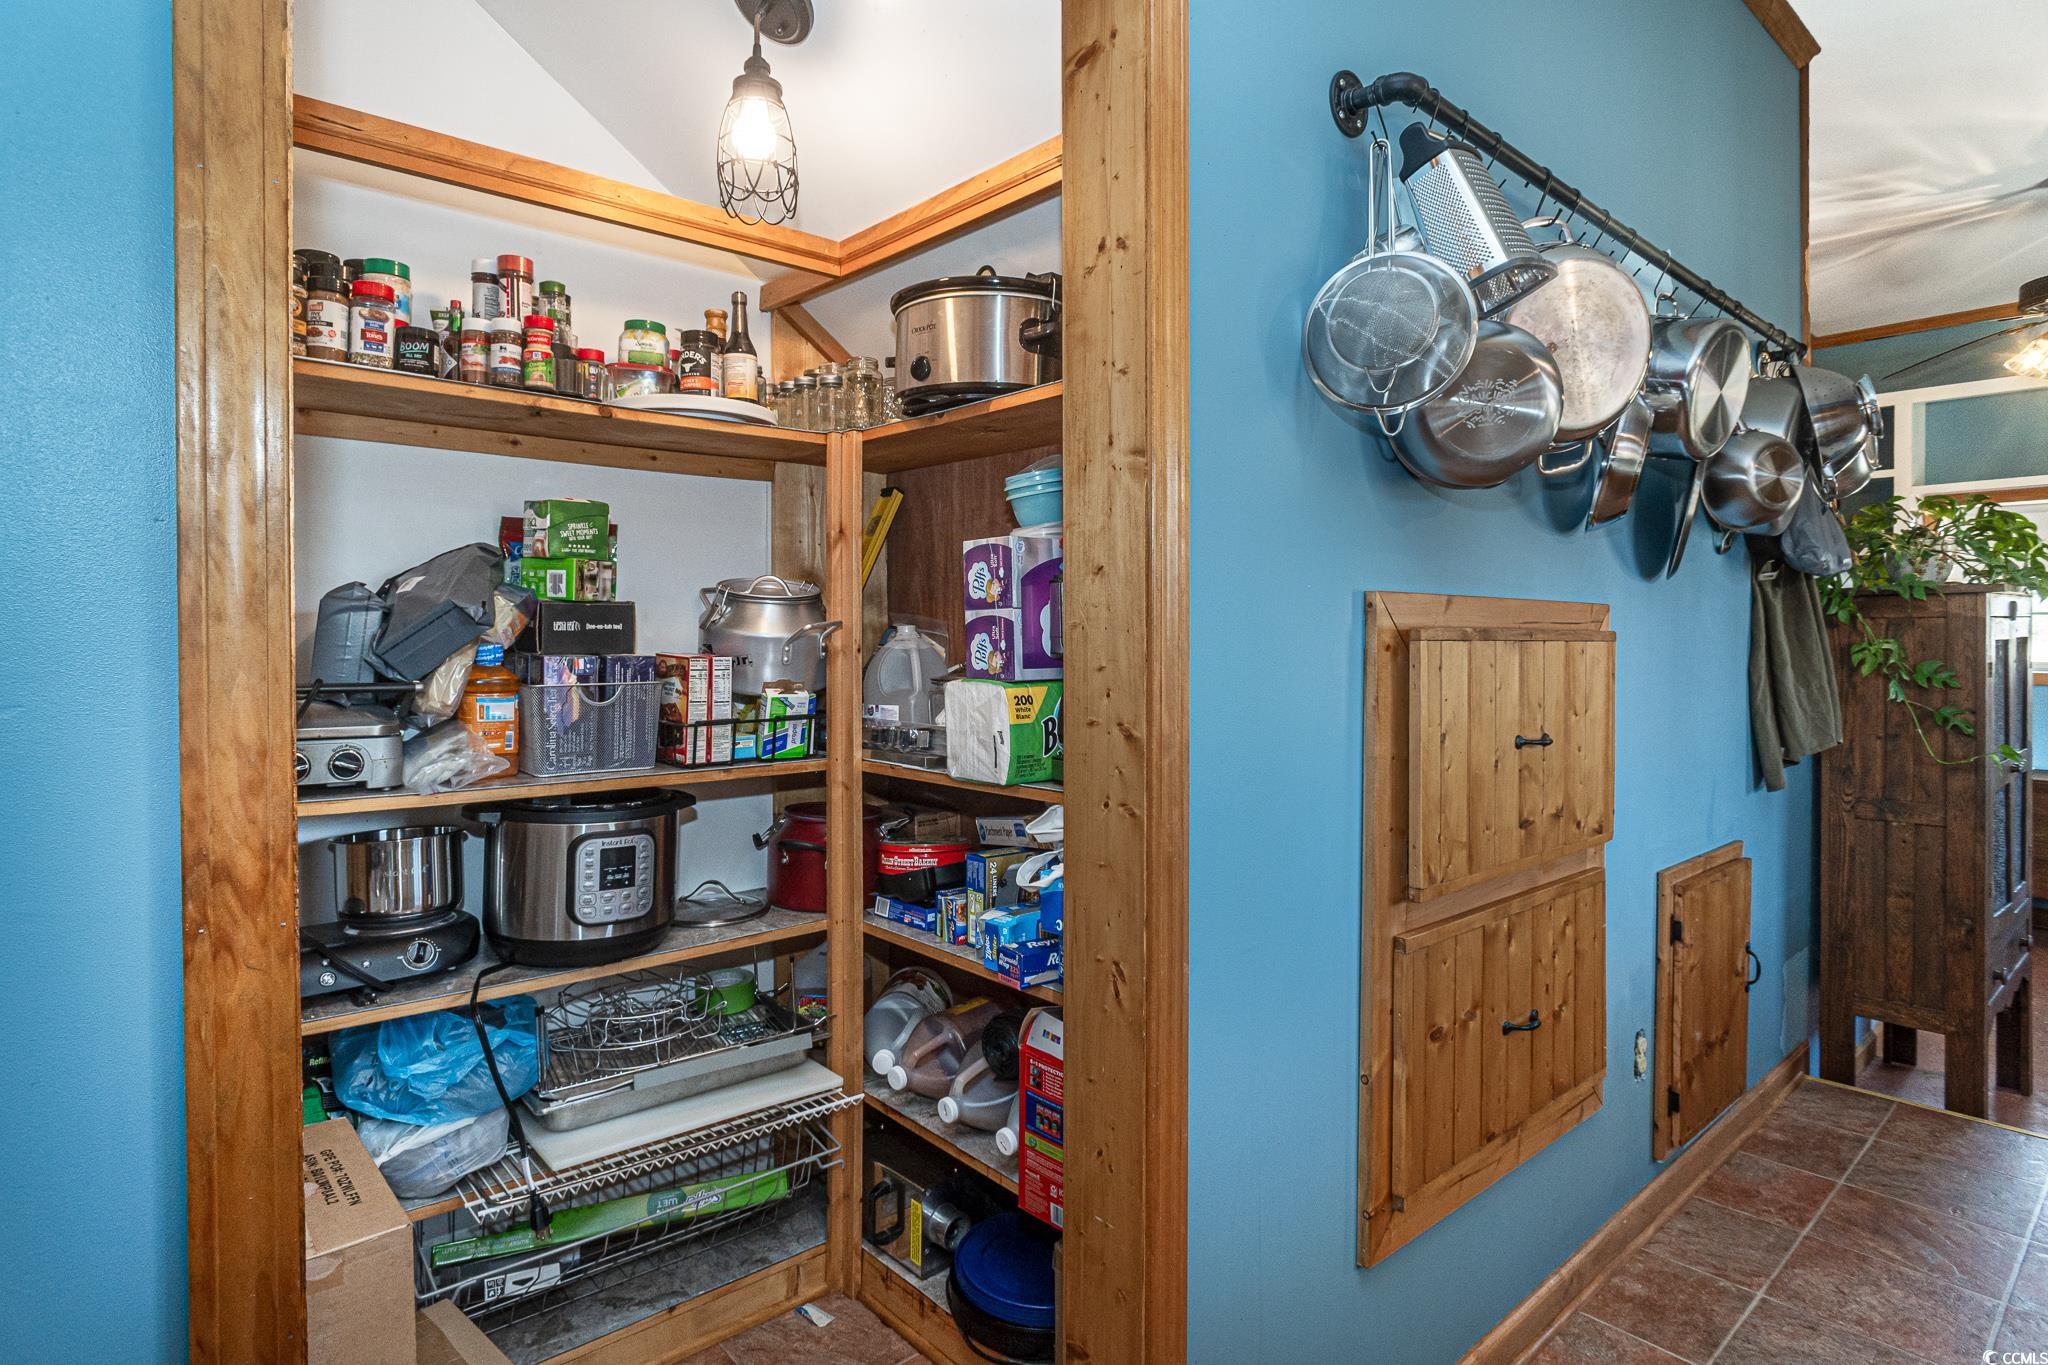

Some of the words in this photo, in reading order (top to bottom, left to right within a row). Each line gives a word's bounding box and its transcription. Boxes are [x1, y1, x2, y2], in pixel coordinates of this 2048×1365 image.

[400, 341, 430, 353] BOOM
[560, 530, 575, 538] SWEET
[972, 566, 986, 594] Puffs
[974, 638, 988, 665] Puffs
[1013, 694, 1034, 706] 200
[624, 837, 635, 845] Pot
[914, 856, 939, 866] BAKERY
[989, 861, 997, 875] 24
[985, 934, 993, 961] Ziploc
[656, 1197, 678, 1208] WET
